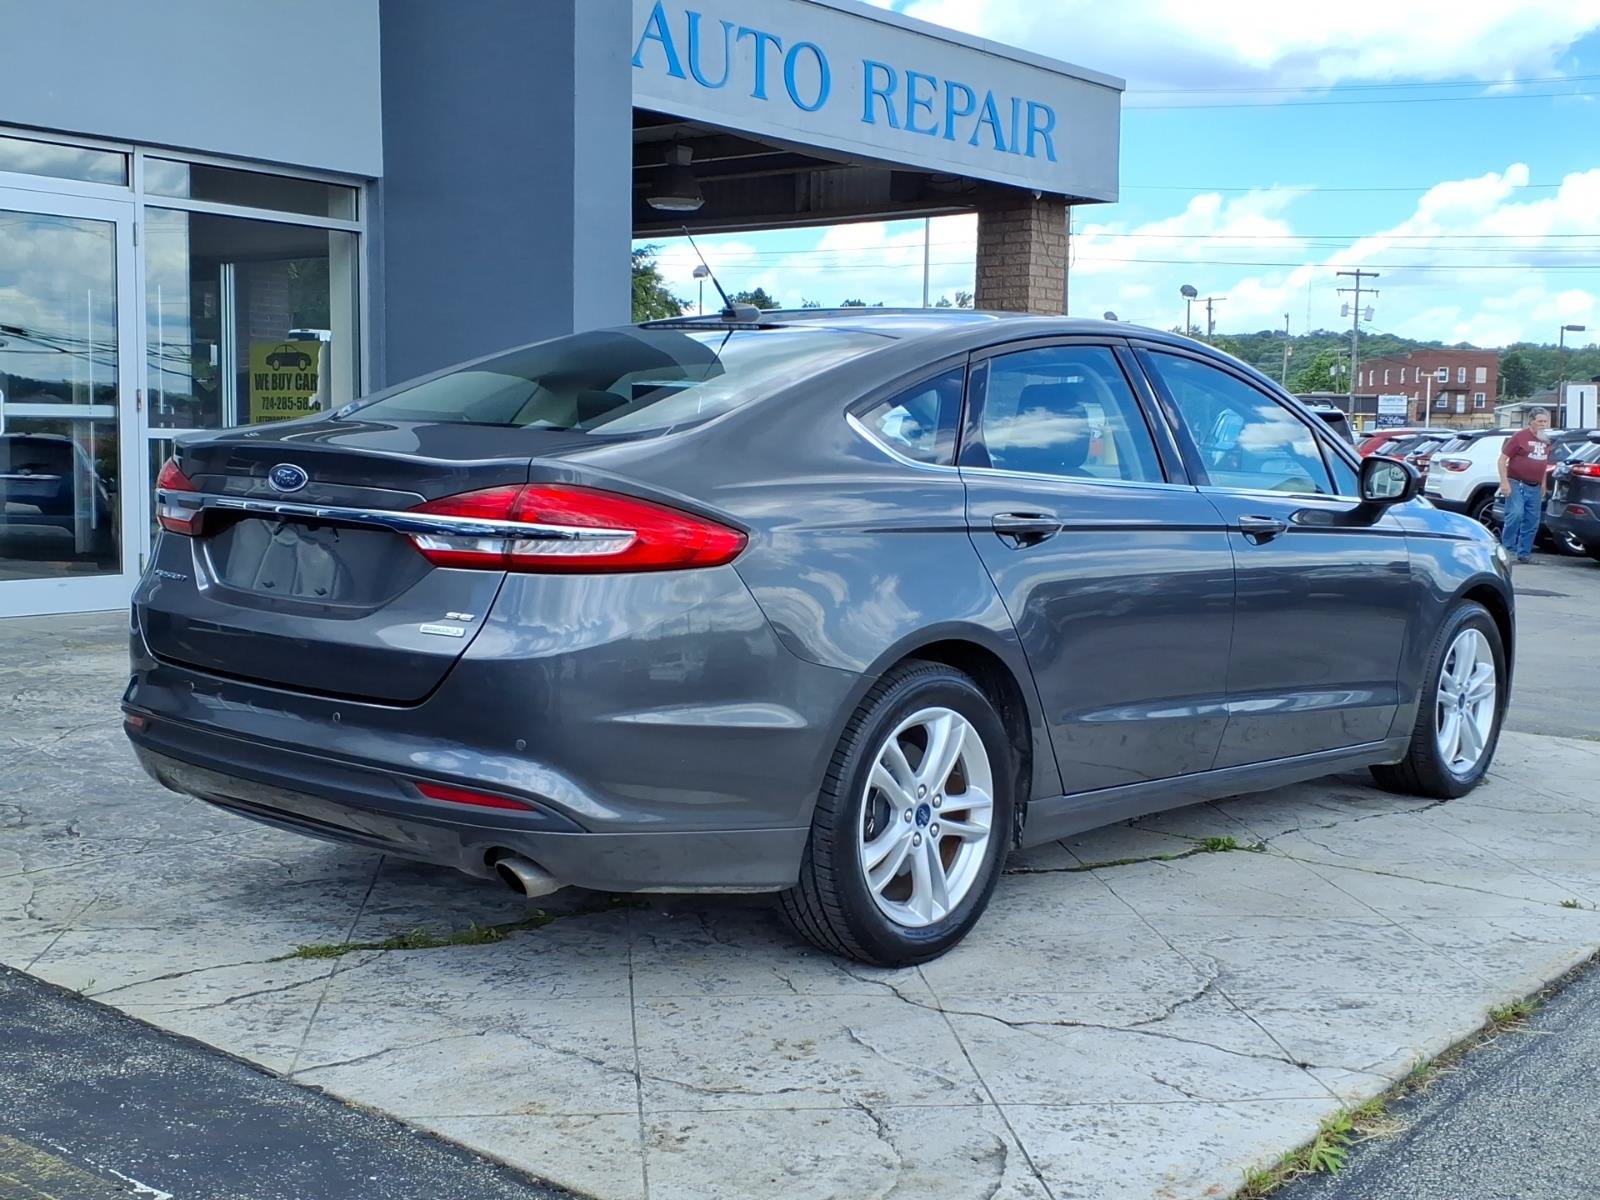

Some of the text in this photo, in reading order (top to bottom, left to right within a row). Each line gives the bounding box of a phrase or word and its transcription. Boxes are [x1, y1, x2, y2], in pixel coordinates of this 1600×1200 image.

[632, 0, 1058, 163] AUTO REPAIR
[254, 373, 269, 391] WE
[271, 373, 292, 391] BUY
